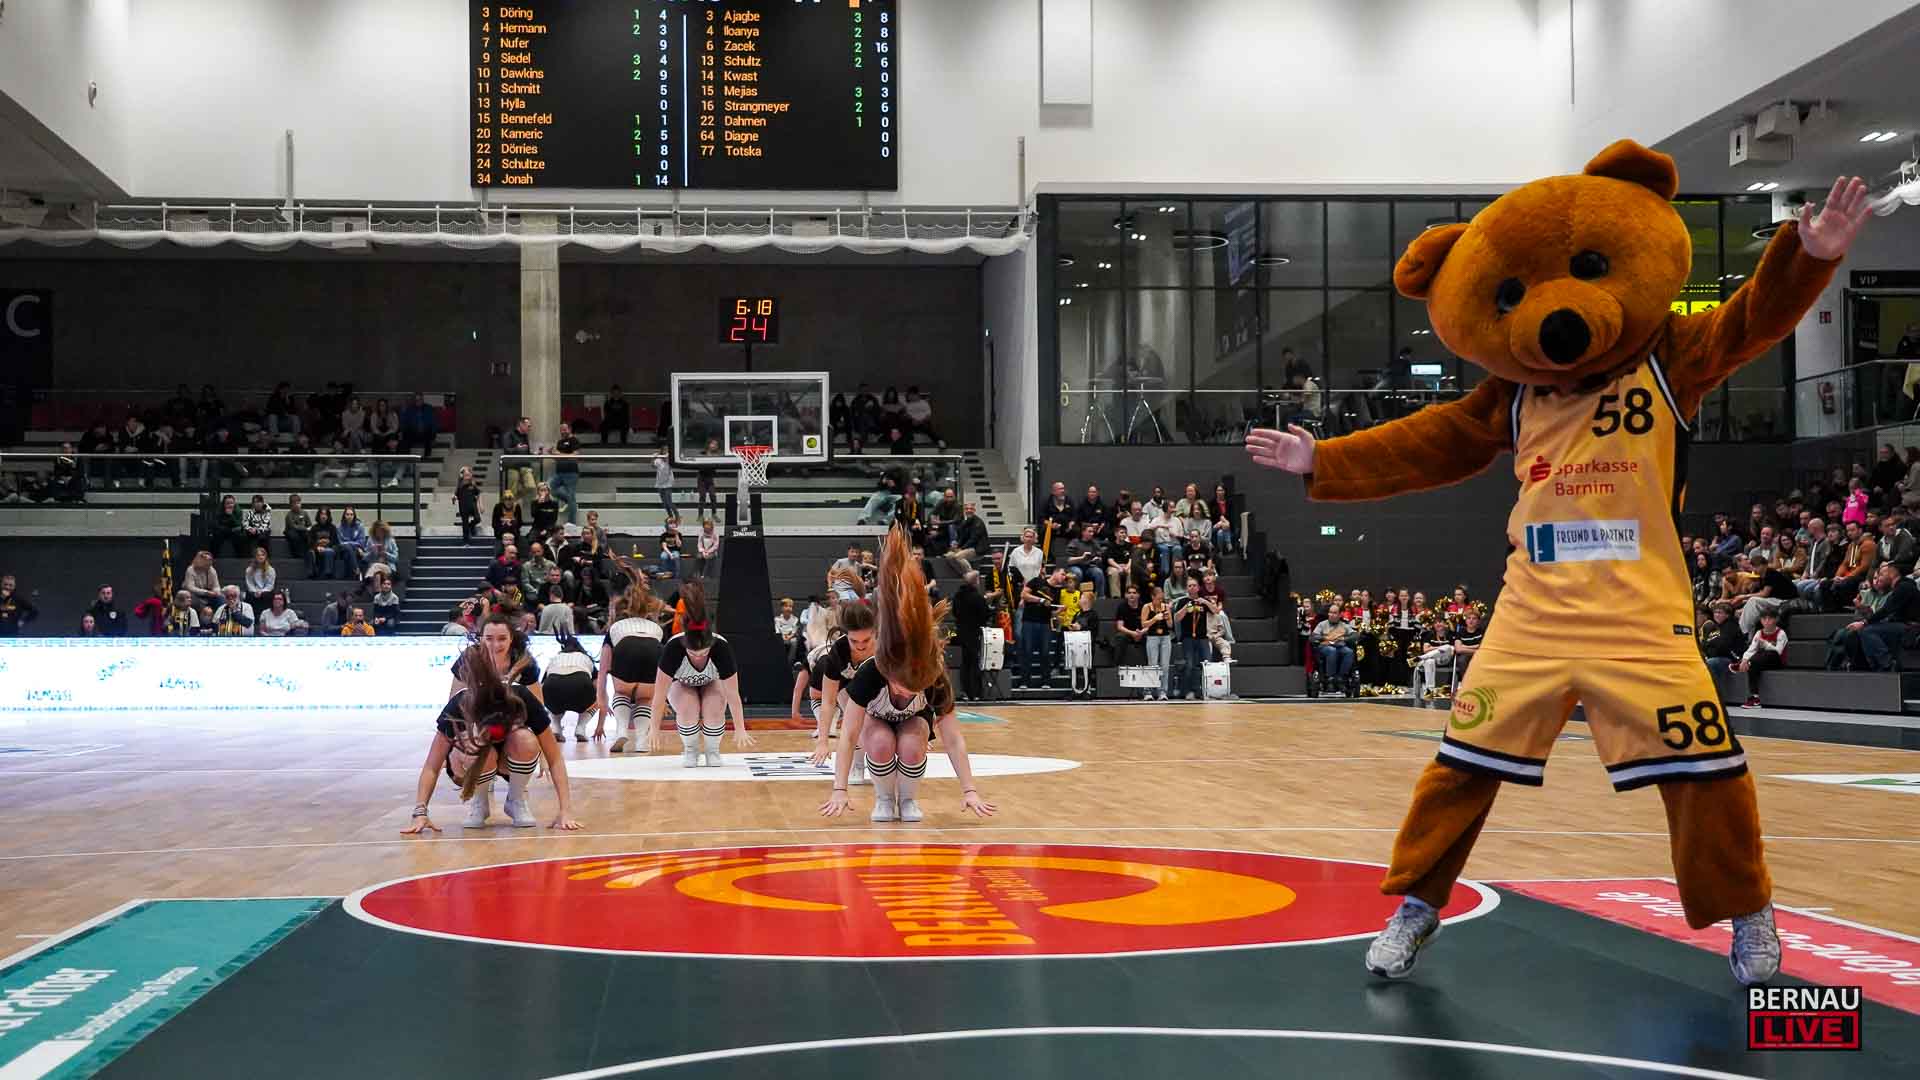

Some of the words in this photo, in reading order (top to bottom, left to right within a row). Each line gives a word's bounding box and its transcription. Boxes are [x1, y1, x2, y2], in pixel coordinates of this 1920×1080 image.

[482, 8, 490, 17] 3
[500, 8, 534, 20] Döring
[634, 10, 640, 19] 1
[658, 10, 667, 20] 4
[706, 11, 714, 21] 3
[723, 11, 761, 23] Ajagbe
[854, 13, 862, 22] 3
[880, 13, 889, 23] 8
[482, 23, 490, 32] 4
[500, 23, 547, 33] Hermann
[633, 25, 641, 34] 2
[659, 25, 668, 35] 3
[706, 26, 714, 35] 4
[854, 28, 862, 37] 2
[880, 28, 889, 37] 8
[482, 37, 490, 47] 7
[500, 37, 529, 48] Nufer
[659, 40, 668, 50] 9
[706, 41, 714, 50] 6
[724, 41, 756, 51] Zacek
[854, 42, 862, 52] 2
[875, 42, 889, 52] 16
[482, 53, 490, 63] 9
[500, 53, 531, 63] Siedel
[633, 55, 641, 64] 3
[659, 55, 668, 65] 4
[701, 56, 714, 65] 13
[724, 56, 762, 66] Schultz
[854, 57, 862, 67] 2
[880, 57, 889, 67] 6
[477, 68, 491, 77] 10
[500, 68, 545, 78] Dawkins
[633, 70, 641, 80] 2
[659, 70, 668, 80] 9
[701, 71, 714, 80] 14
[723, 71, 758, 81] Kwast
[880, 72, 889, 82] 0
[477, 83, 490, 93] 11
[500, 83, 541, 93] Schmitt
[660, 85, 668, 95] 5
[701, 86, 714, 95] 15
[723, 86, 758, 98] Mejias
[855, 88, 863, 97] 3
[881, 87, 889, 97] 3
[478, 98, 491, 108] 13
[500, 98, 526, 111] Hylla
[659, 100, 668, 110] 0
[701, 101, 715, 110] 16
[724, 101, 790, 113] Strangmeyer
[855, 102, 863, 112] 2
[881, 102, 889, 112] 6
[477, 113, 491, 123] 15
[500, 113, 553, 124] Bennefeld
[635, 115, 640, 124] 1
[661, 115, 667, 125] 1
[700, 116, 715, 125] 22
[724, 116, 767, 126] Dahmen
[856, 117, 862, 127] 1
[881, 117, 889, 127] 0
[476, 128, 491, 138] 20
[501, 128, 544, 139] Kameric
[634, 130, 641, 140] 2
[660, 130, 668, 140] 5
[700, 131, 715, 140] 64
[724, 130, 759, 143] Diagne
[881, 132, 889, 142] 0
[476, 144, 491, 153] 22
[501, 144, 538, 154] Dörries
[635, 145, 641, 154] 1
[660, 145, 669, 155] 8
[700, 146, 715, 155] 77
[725, 146, 762, 156] Totska
[881, 147, 890, 157] 0
[476, 159, 491, 168] 24
[501, 159, 545, 169] Schultze
[660, 160, 669, 170] 0
[477, 173, 491, 183] 34
[501, 174, 534, 184] Jonah
[635, 175, 641, 185] 1
[655, 175, 669, 185] 14
[1860, 275, 1877, 285] VIP
[6, 295, 40, 337] C
[730, 317, 767, 341] 24
[1591, 387, 1655, 437] 58
[1555, 480, 1615, 496] Barnim
[1556, 528, 1590, 543] FREUND
[1599, 528, 1635, 541] PARTNER
[1656, 700, 1725, 751] 58
[857, 873, 1037, 947] BERNAU
